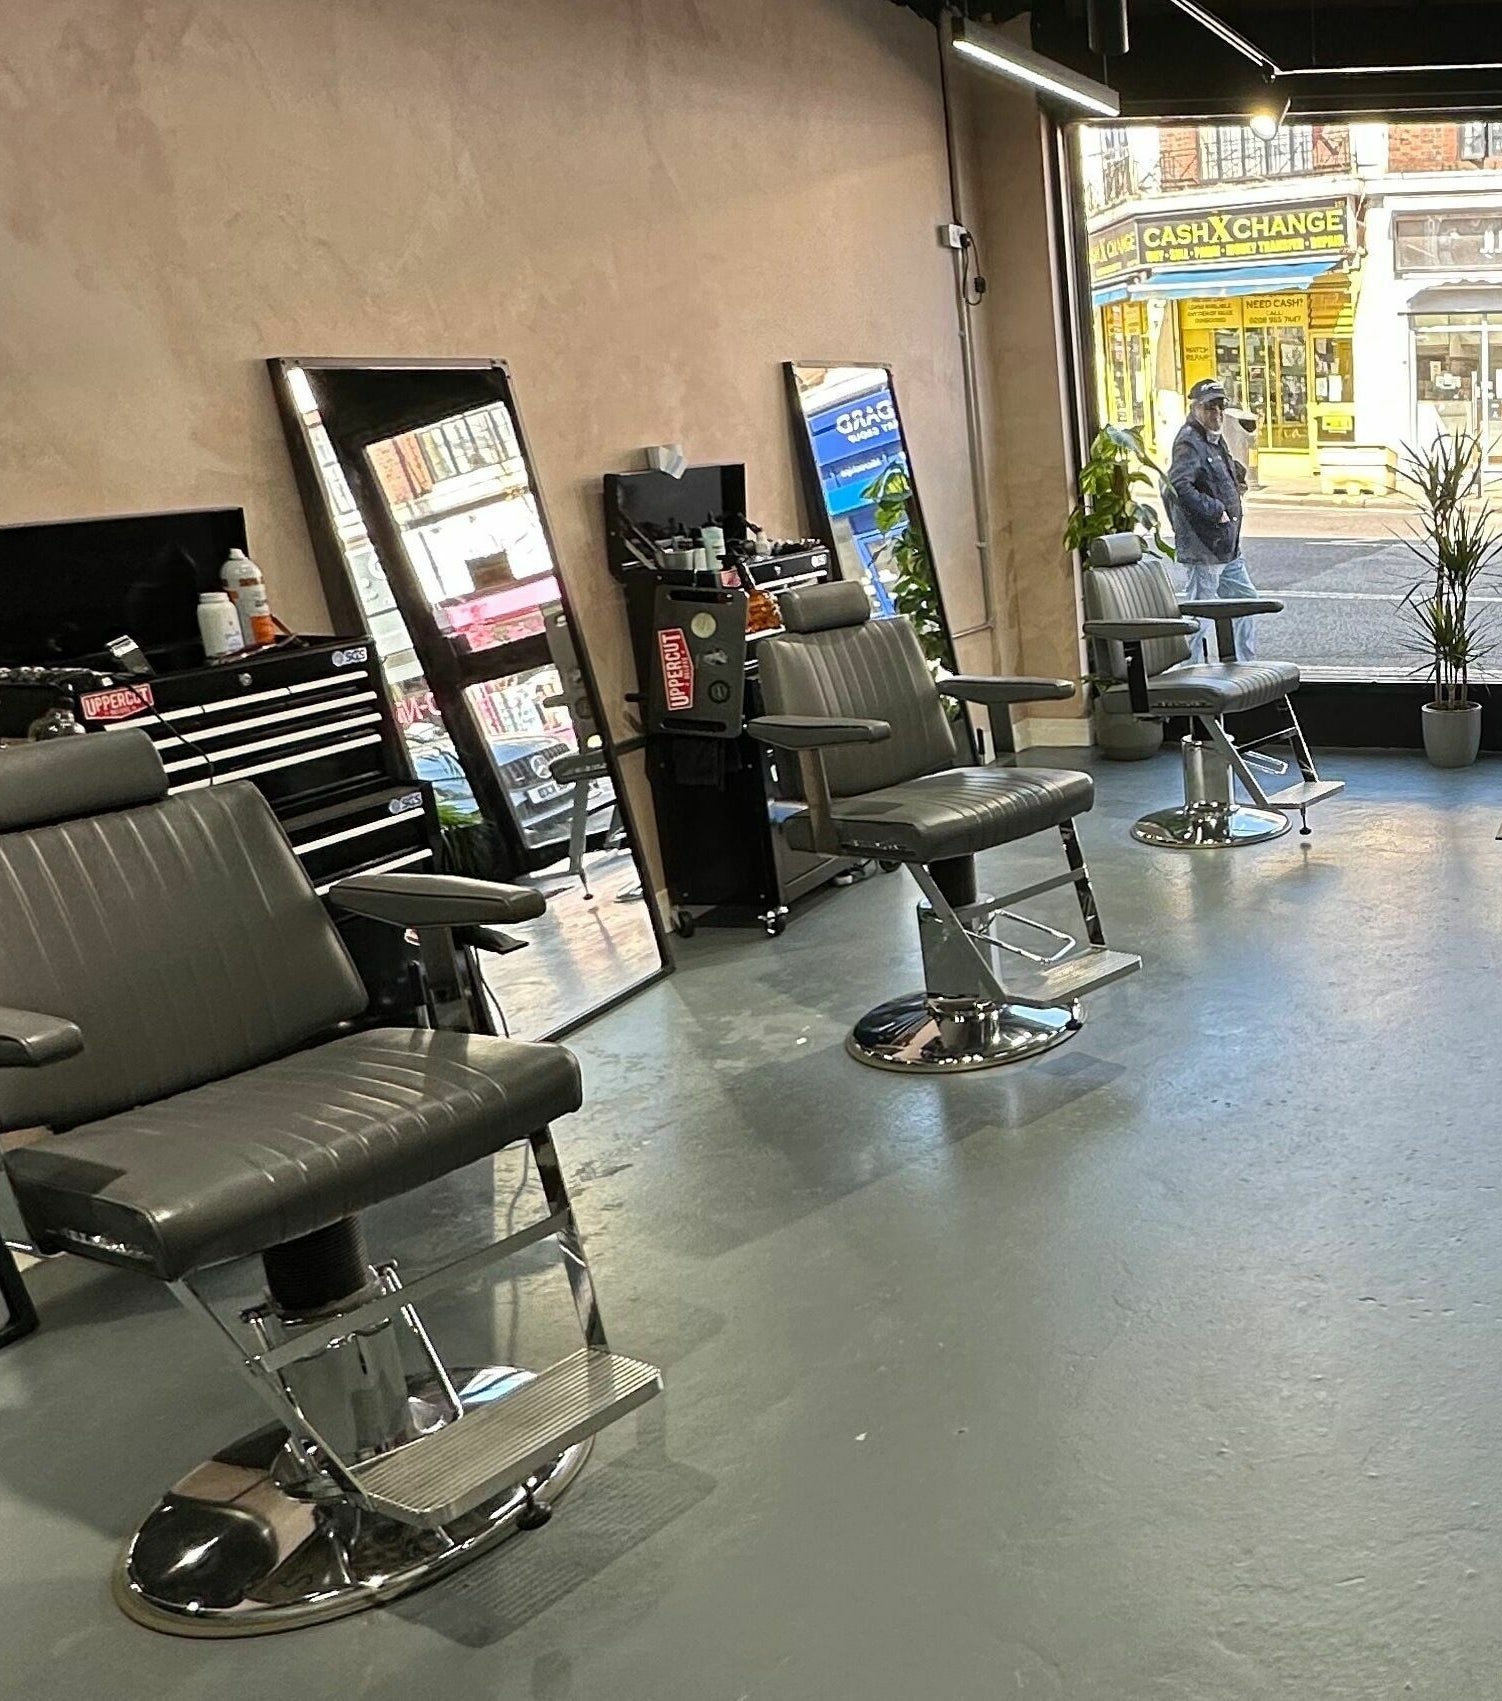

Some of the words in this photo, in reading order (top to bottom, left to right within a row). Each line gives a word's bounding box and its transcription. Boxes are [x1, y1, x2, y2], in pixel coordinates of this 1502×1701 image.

[1246, 300, 1272, 309] NEED
[660, 631, 690, 708] UPPERCUT
[85, 687, 149, 717] UPPERCUT
